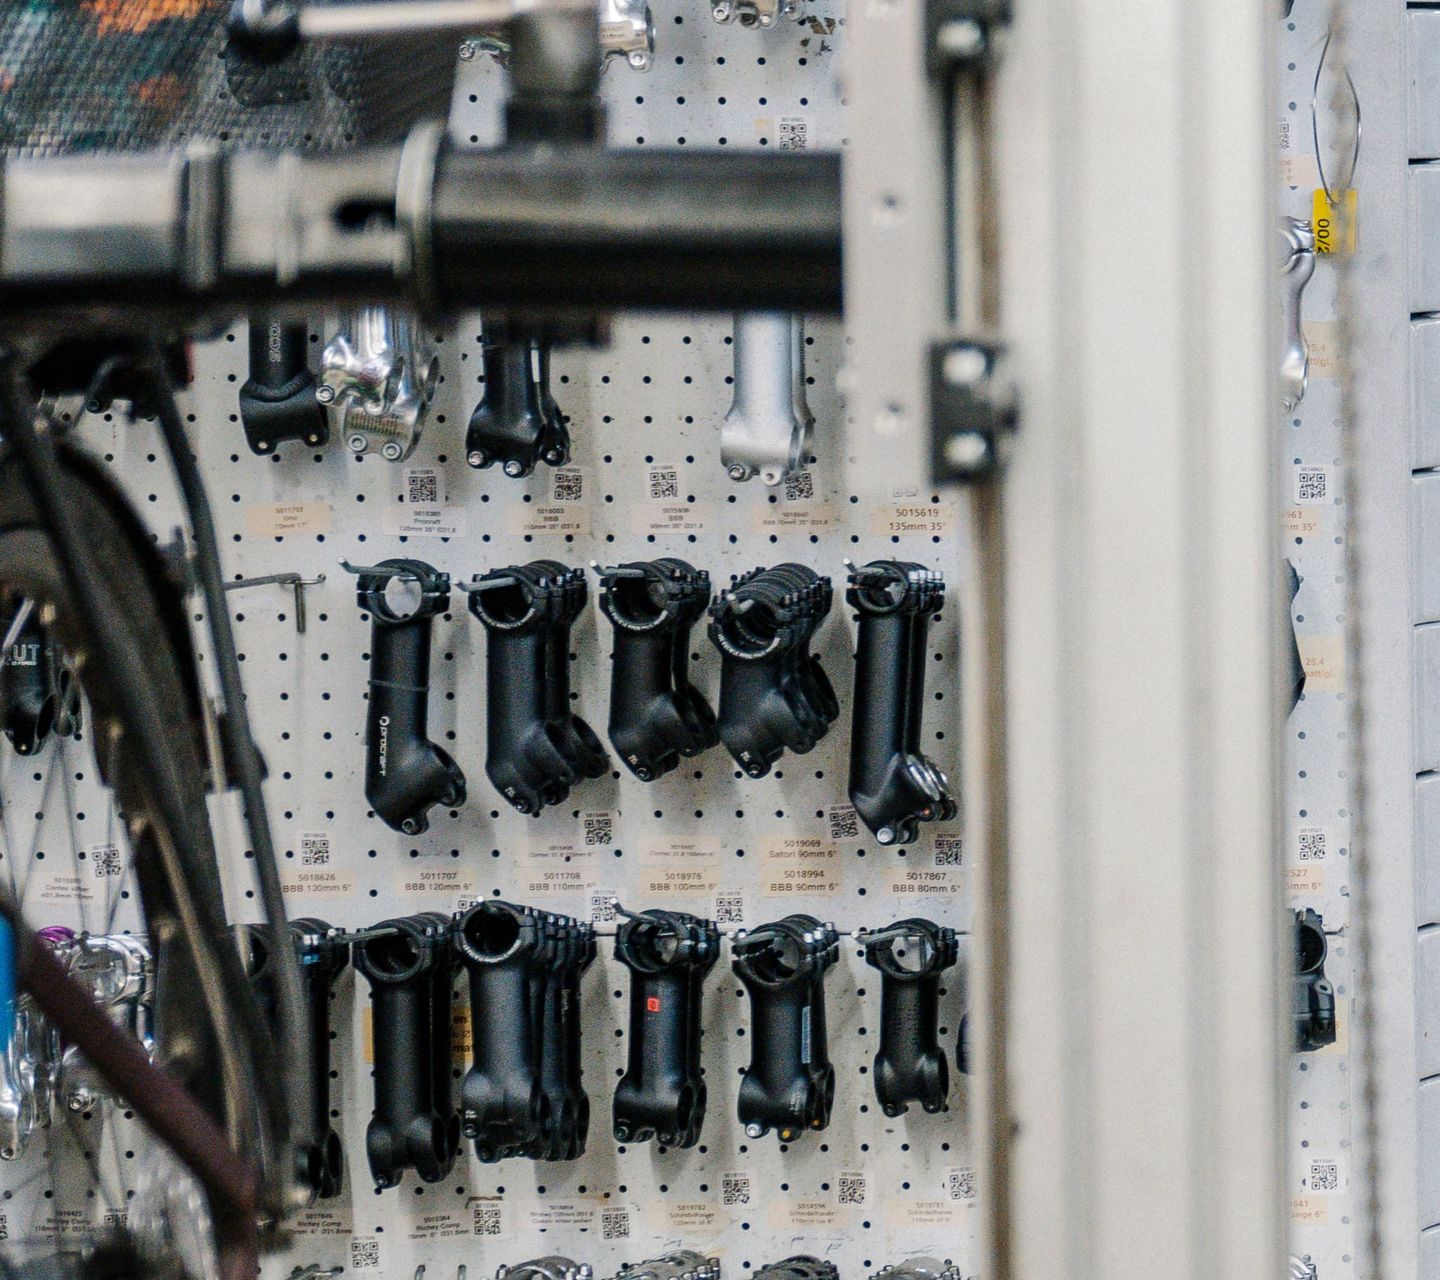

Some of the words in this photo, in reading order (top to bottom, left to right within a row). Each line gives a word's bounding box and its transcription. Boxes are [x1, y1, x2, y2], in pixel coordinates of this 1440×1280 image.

[895, 508, 939, 518] 5015619
[888, 522, 927, 531] 135mm
[768, 850, 796, 858] Satori
[420, 872, 457, 880] 5011707
[906, 872, 946, 880] 5017867
[282, 884, 305, 893] BBB
[307, 884, 339, 893] 130mm
[405, 883, 426, 891] BBB
[428, 883, 465, 891] 120mm
[529, 883, 551, 891] BBB
[552, 883, 584, 891] 110mm
[650, 883, 671, 891] BBB
[673, 883, 706, 891] 100mm
[769, 883, 792, 892] BBB
[892, 884, 915, 892] BBB
[917, 884, 948, 892] 80mm
